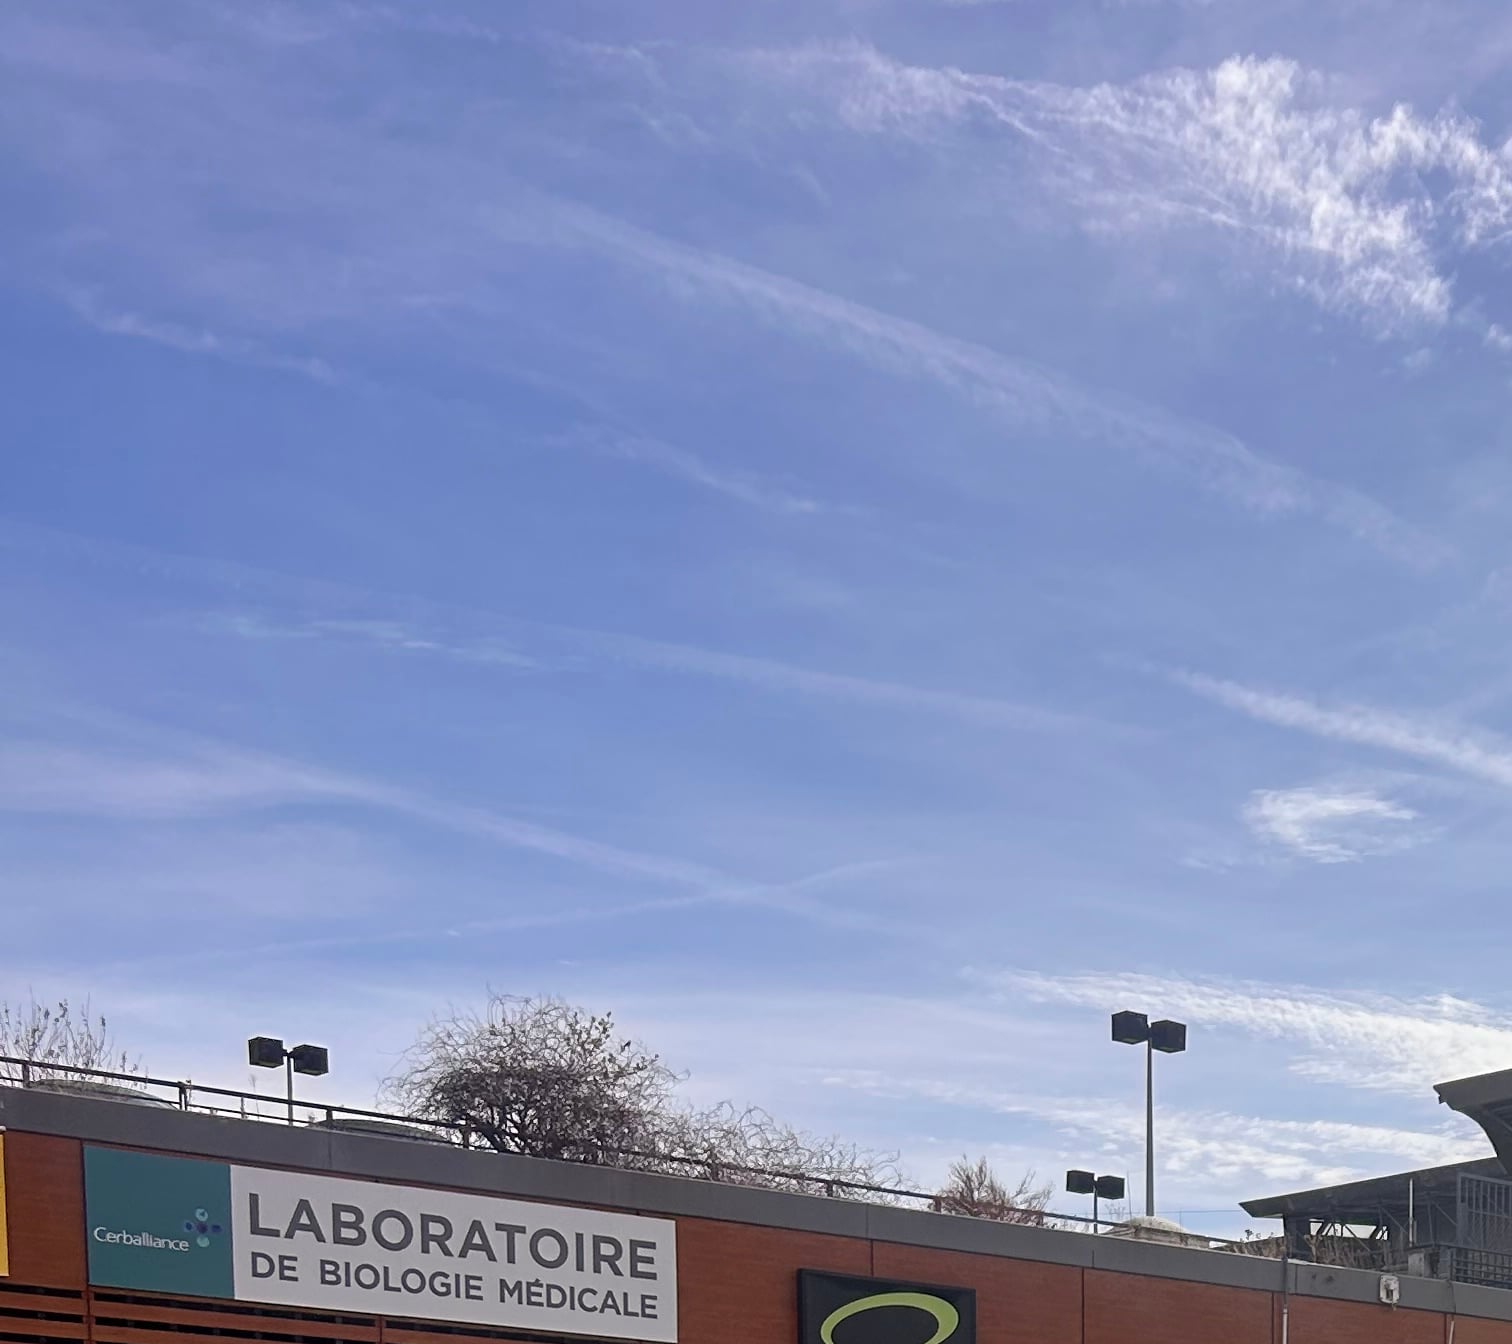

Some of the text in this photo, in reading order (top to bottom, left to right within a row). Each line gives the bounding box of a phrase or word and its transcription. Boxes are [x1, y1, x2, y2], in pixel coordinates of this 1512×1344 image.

[93, 1226, 190, 1252] Cerballiance
[248, 1193, 658, 1281] LABORATOIRE
[251, 1251, 659, 1320] DE BIOLOGIE MÉDICALE
